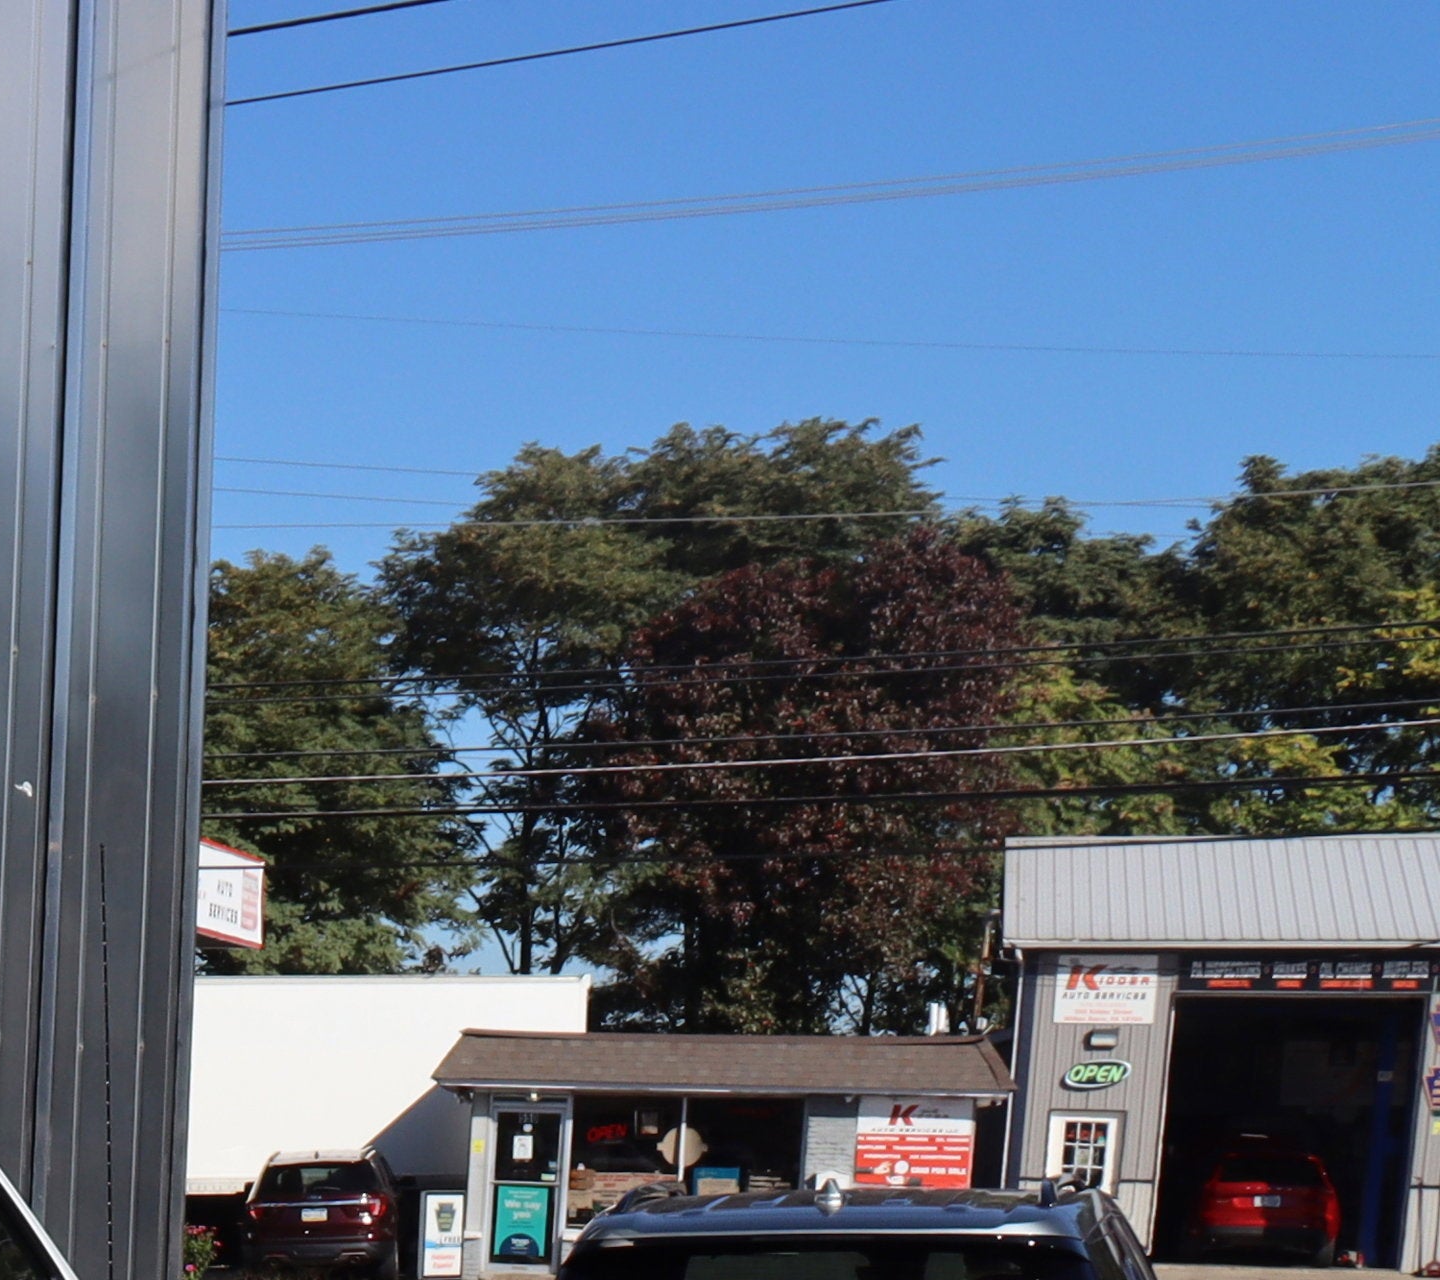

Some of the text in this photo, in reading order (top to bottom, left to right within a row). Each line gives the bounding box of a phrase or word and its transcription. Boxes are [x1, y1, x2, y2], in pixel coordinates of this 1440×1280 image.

[1062, 992, 1147, 1000] AUTO SERVICES
[1069, 1064, 1125, 1082] OPEN
[586, 1123, 628, 1144] OPEN
